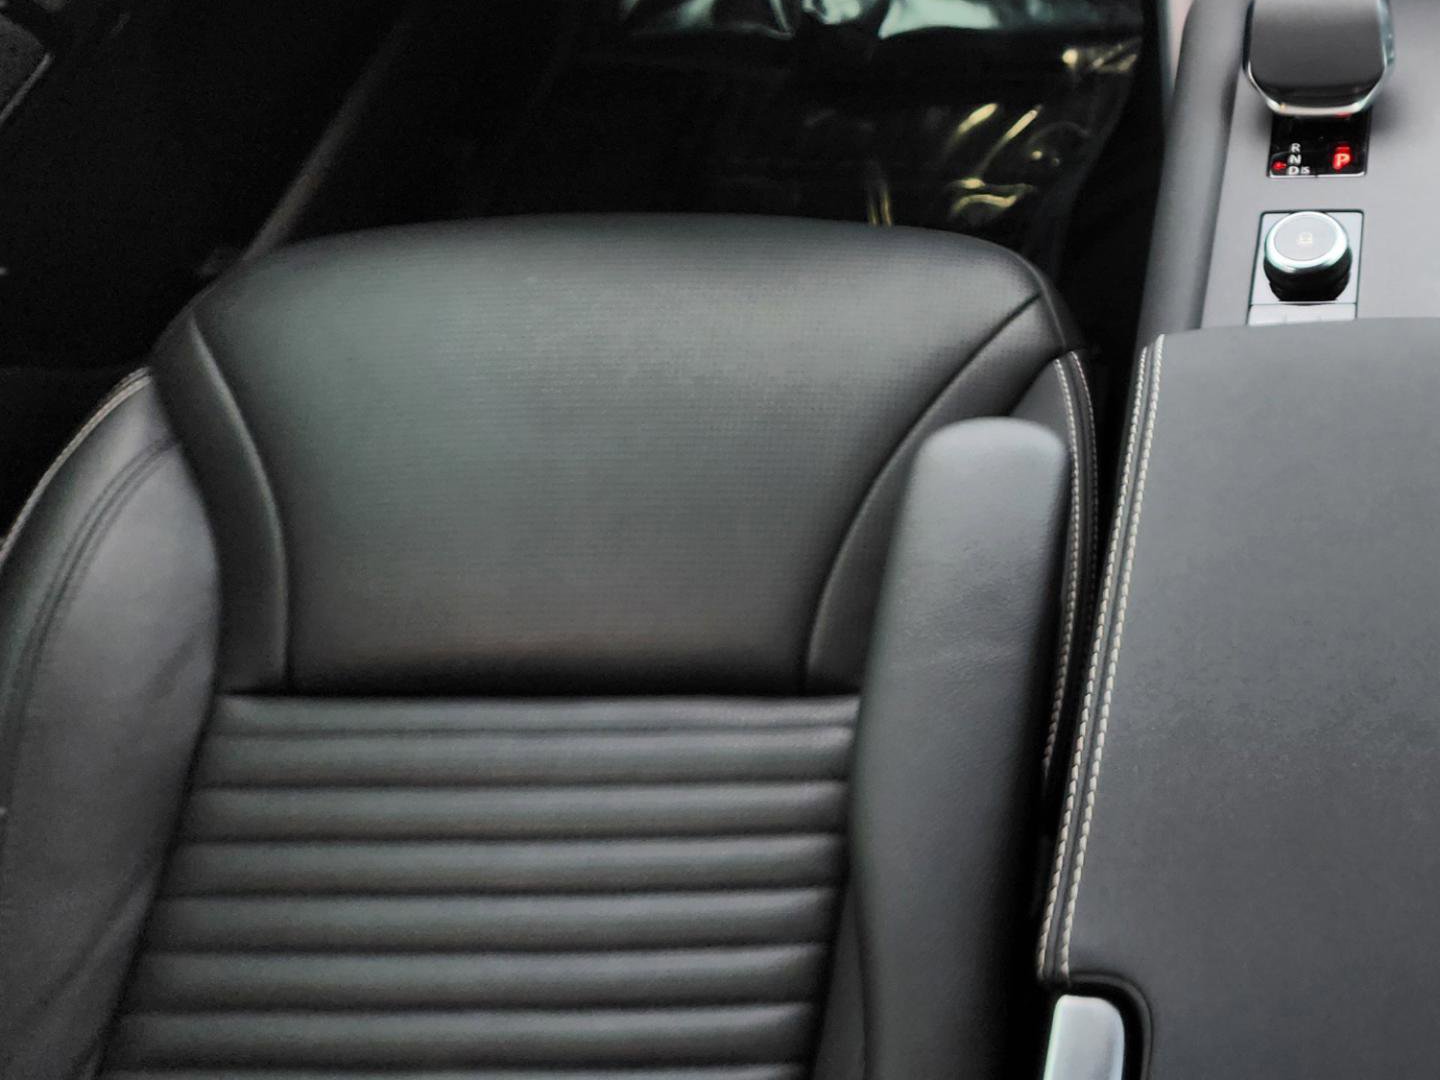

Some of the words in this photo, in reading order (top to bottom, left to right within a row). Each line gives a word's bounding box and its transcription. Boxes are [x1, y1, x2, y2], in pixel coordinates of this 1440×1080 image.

[1291, 143, 1301, 152] R
[1288, 154, 1301, 164] N
[1333, 153, 1351, 169] P
